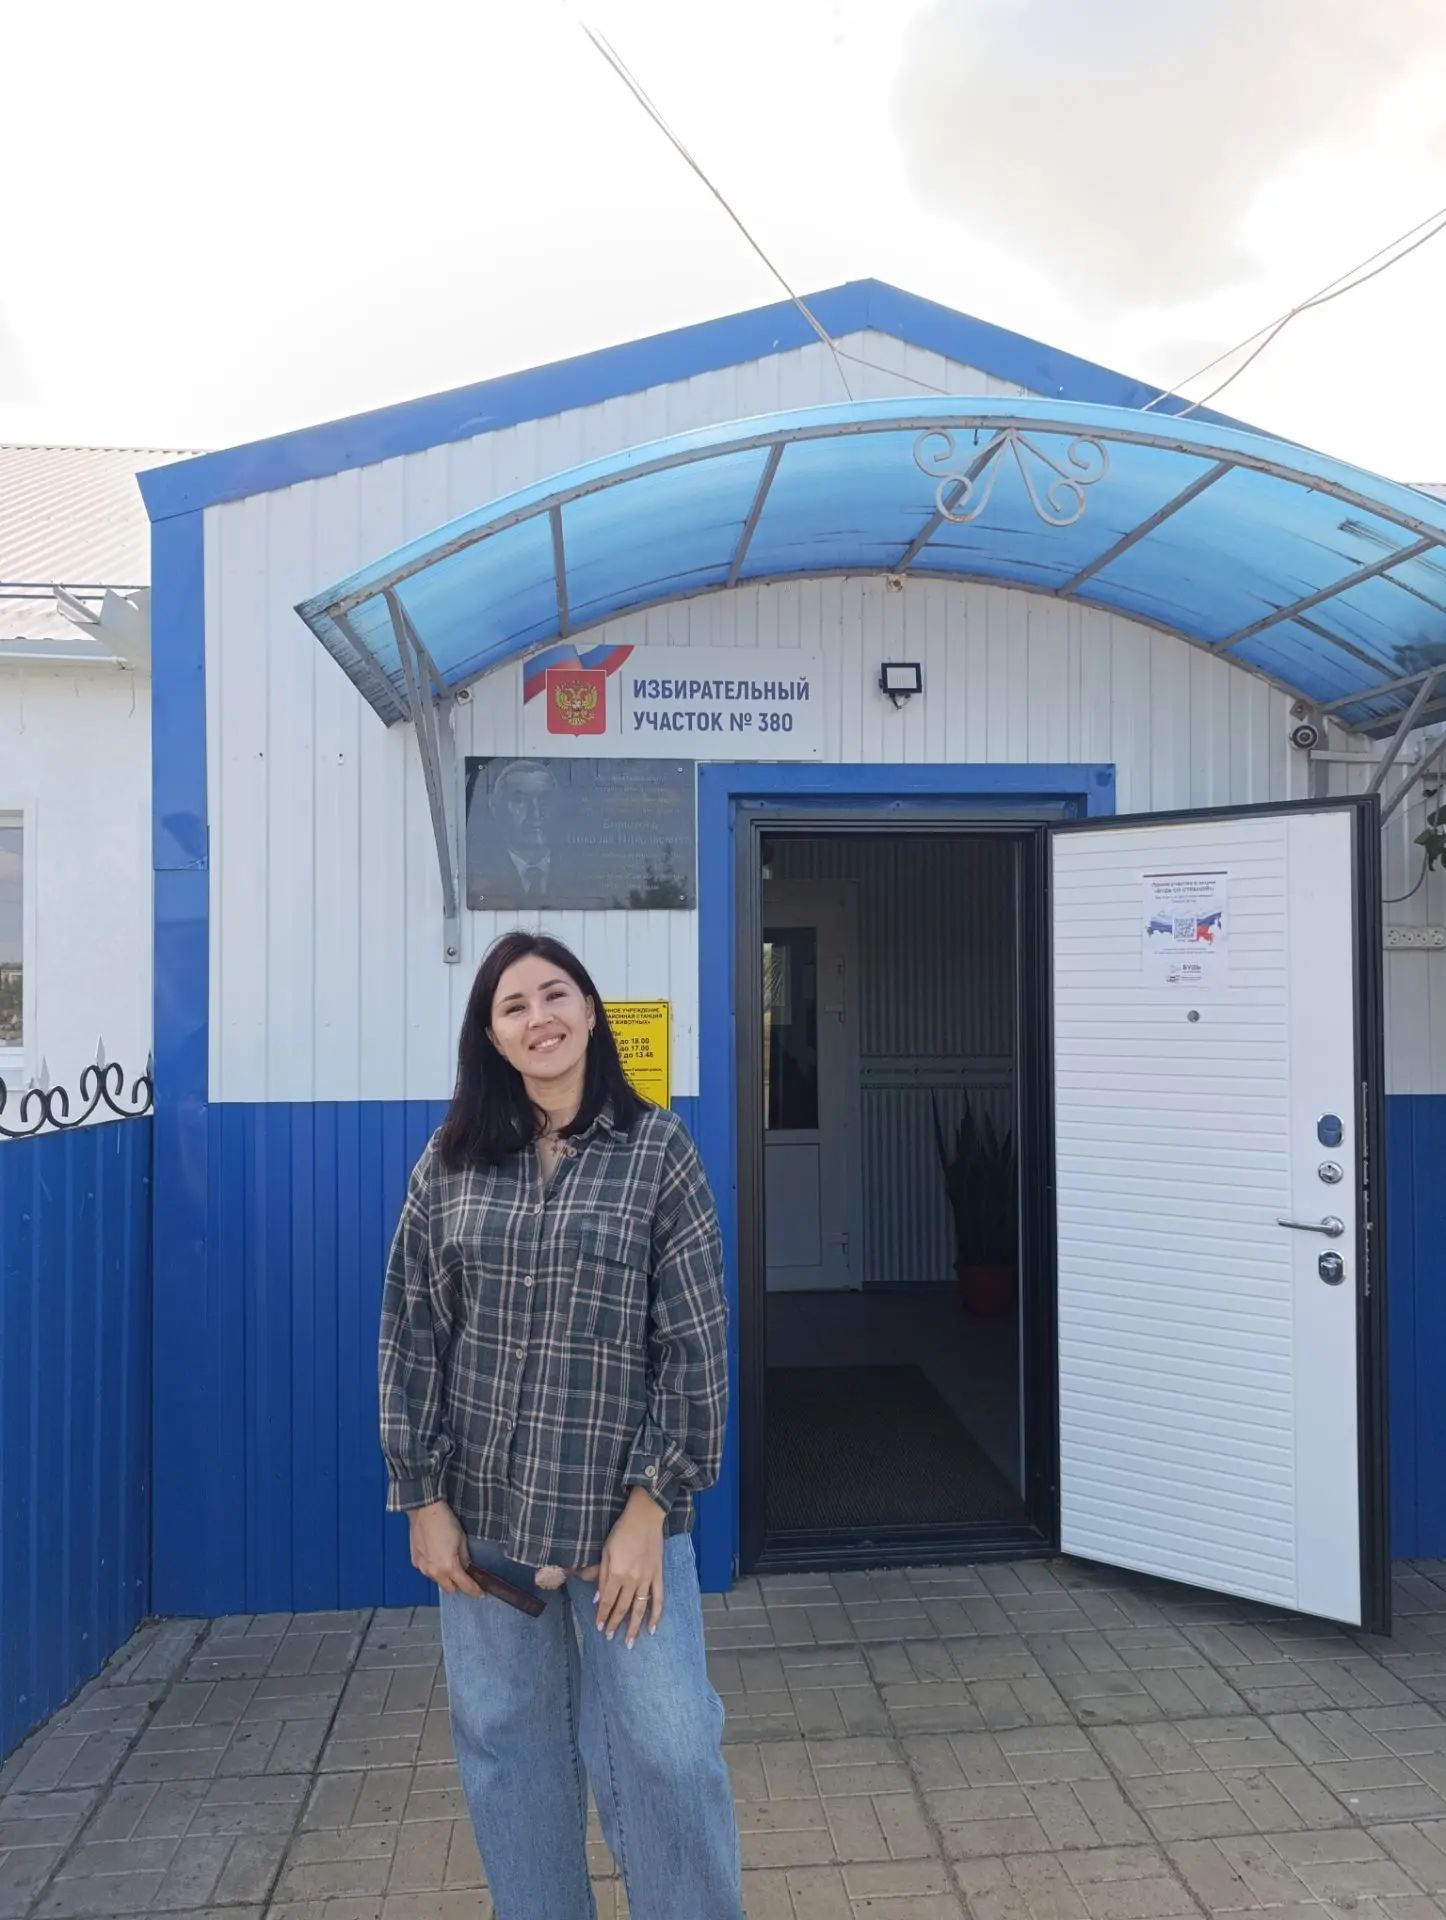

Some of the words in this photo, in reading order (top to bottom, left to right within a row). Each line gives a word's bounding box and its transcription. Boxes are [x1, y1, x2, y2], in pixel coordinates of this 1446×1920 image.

[633, 677, 810, 701] ИЗБИРАТЕЛЬНЫЙ
[633, 711, 724, 732] УЧАСТОК
[729, 712, 753, 732] №
[758, 712, 793, 732] 380
